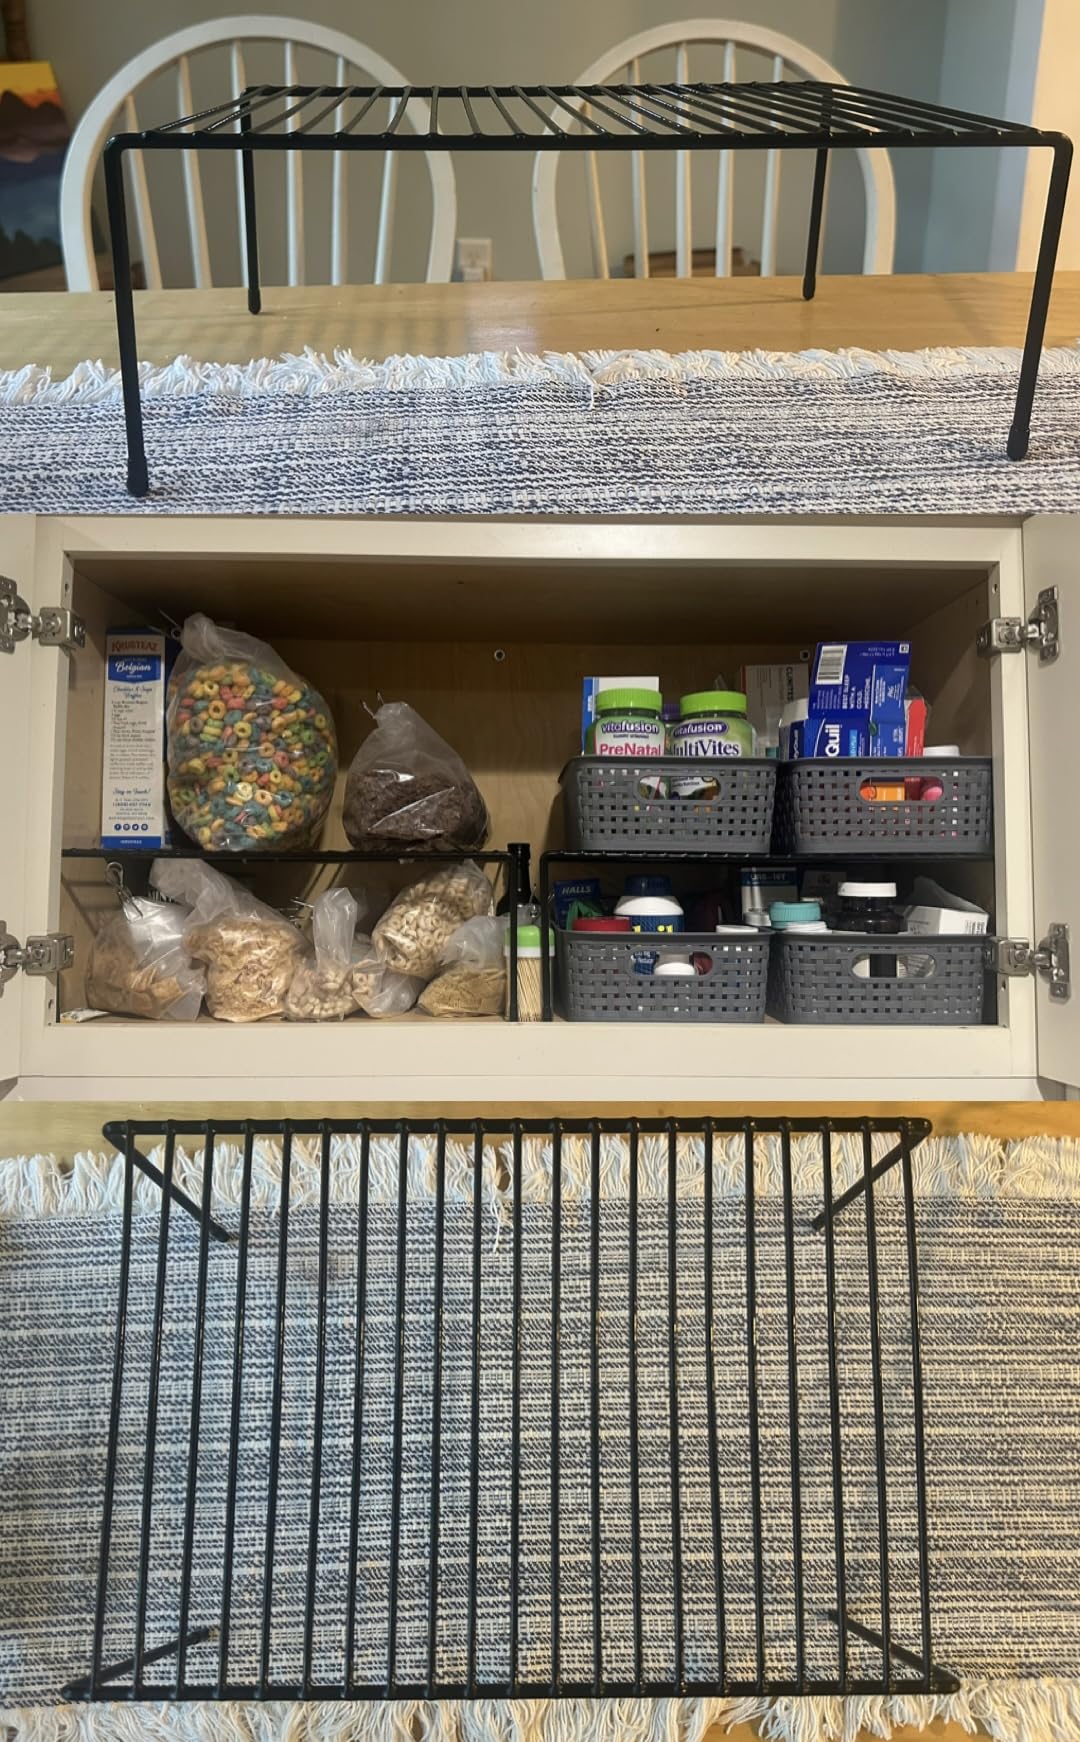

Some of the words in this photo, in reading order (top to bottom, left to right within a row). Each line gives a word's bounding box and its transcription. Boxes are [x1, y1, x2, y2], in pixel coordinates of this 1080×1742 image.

[115, 660, 152, 675] Belgian
[602, 720, 660, 734] vitafusion
[600, 743, 661, 756] PreNatal
[562, 886, 592, 895] HALLS
